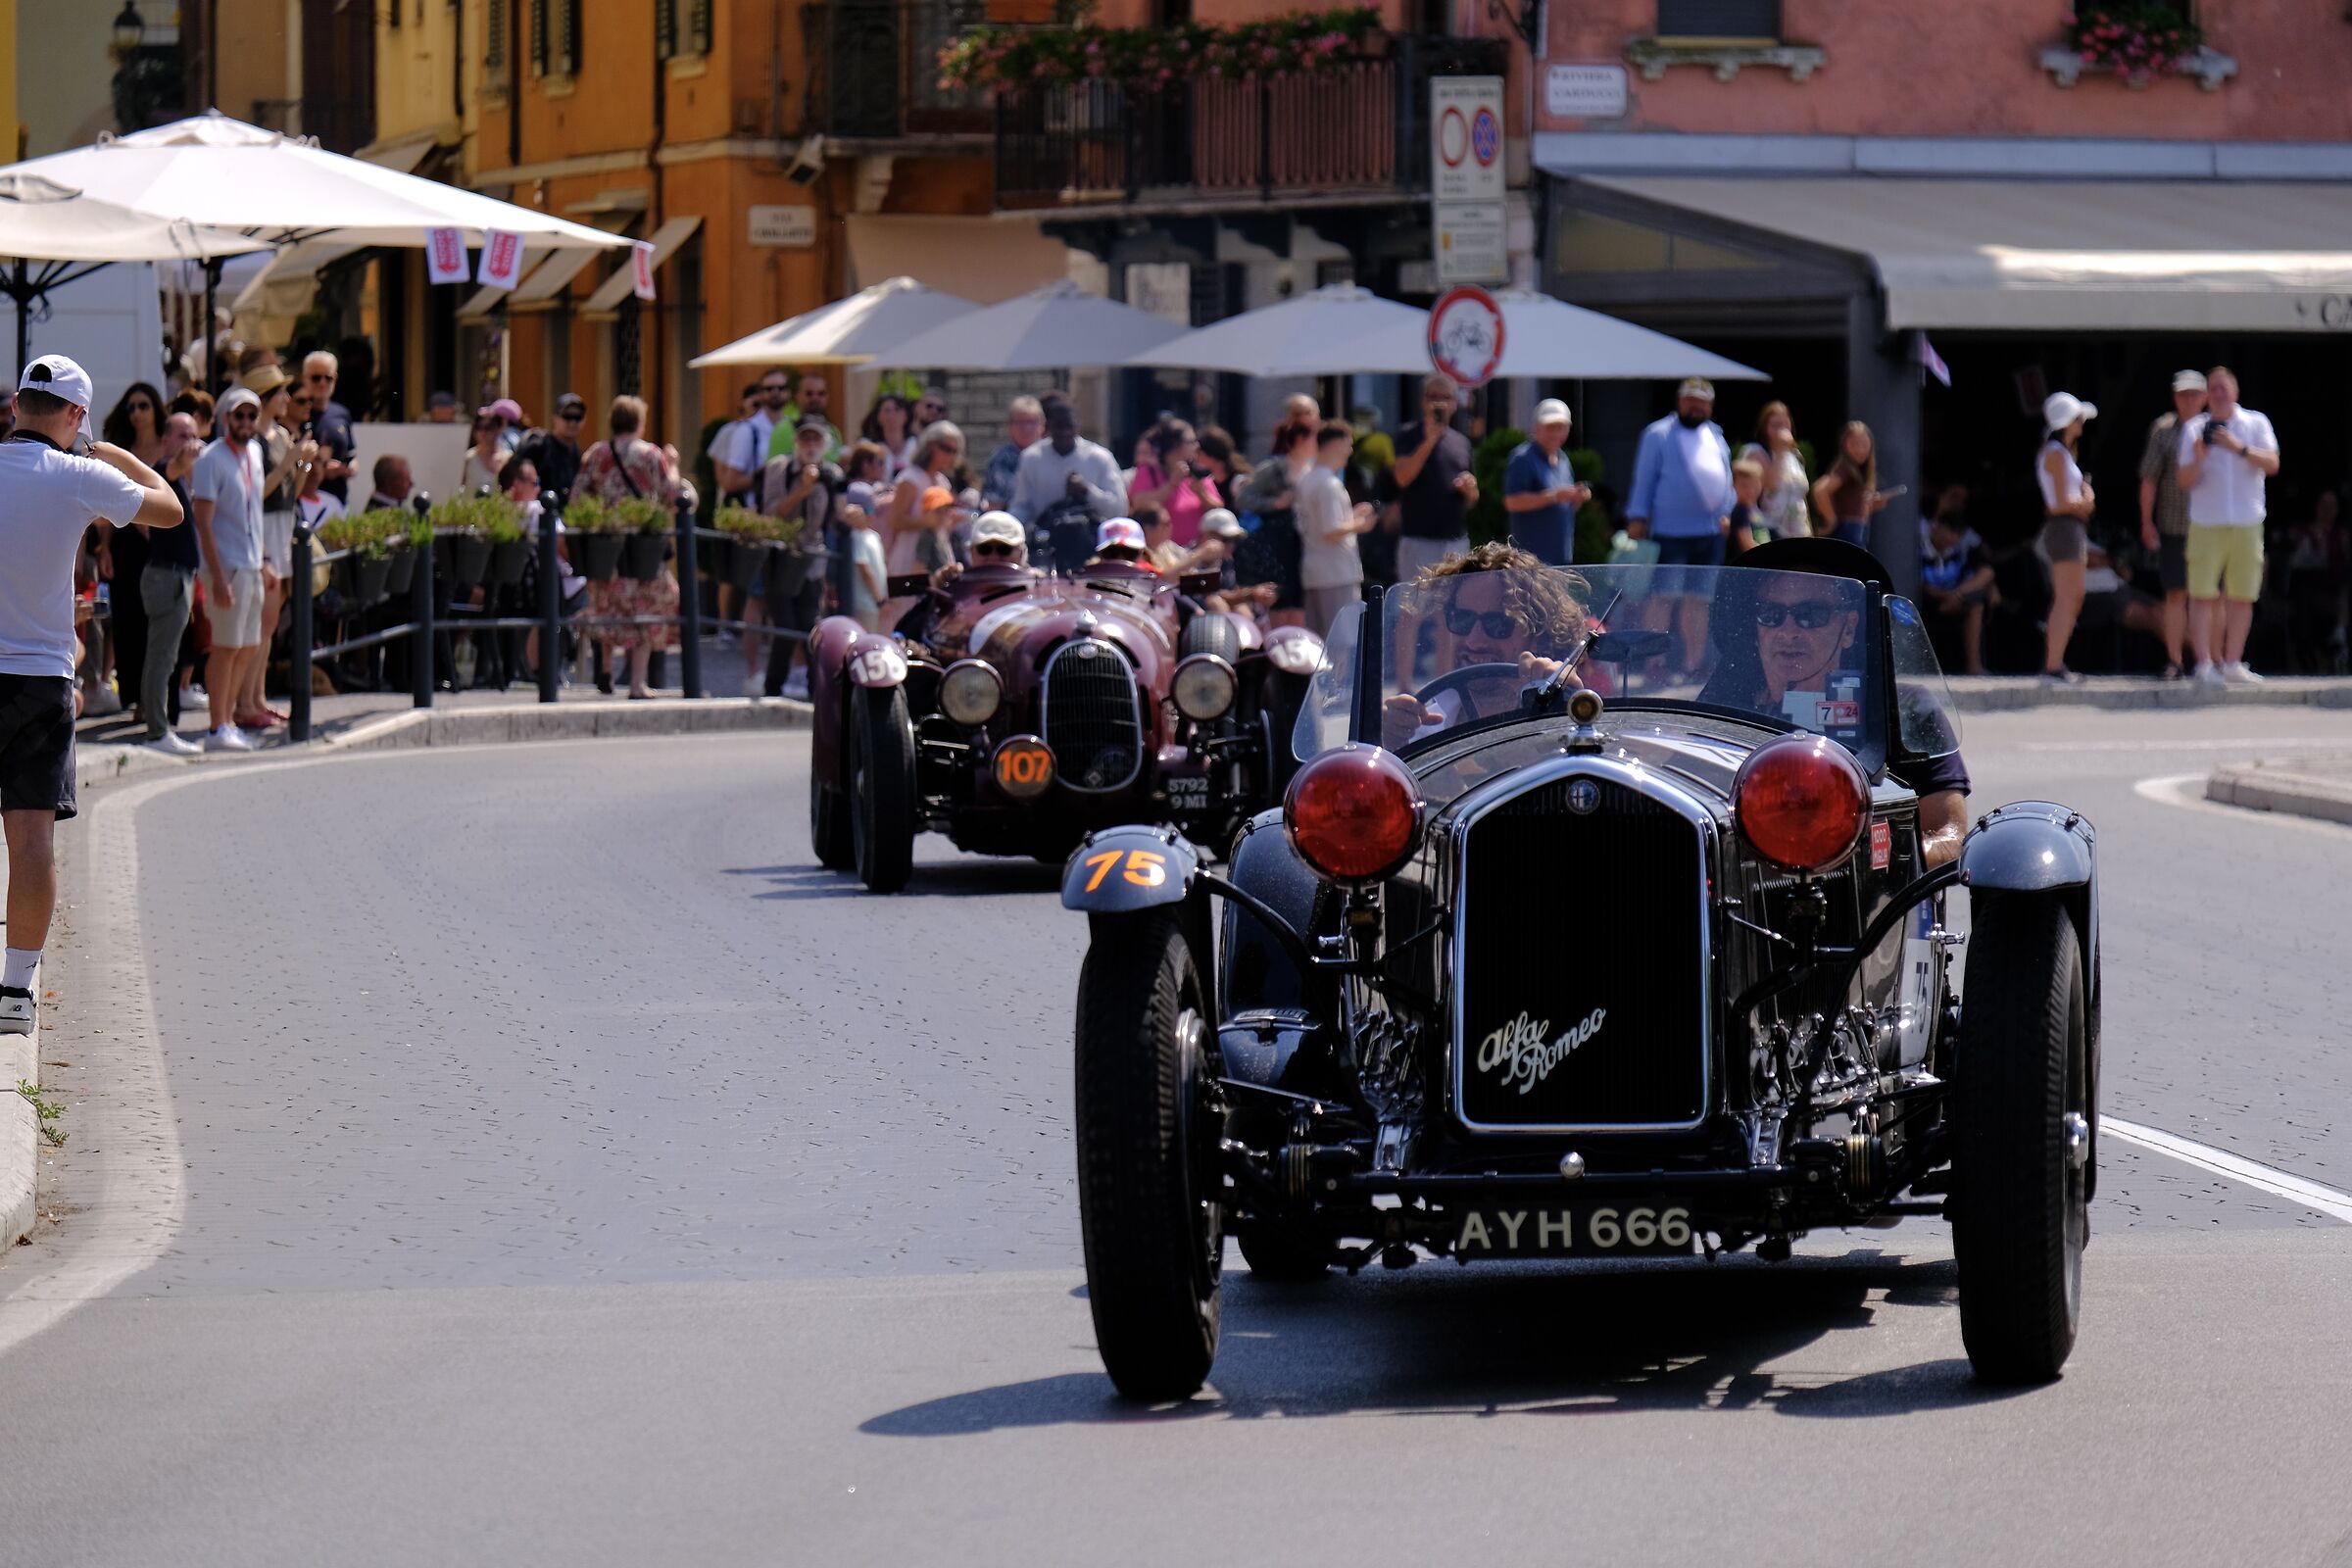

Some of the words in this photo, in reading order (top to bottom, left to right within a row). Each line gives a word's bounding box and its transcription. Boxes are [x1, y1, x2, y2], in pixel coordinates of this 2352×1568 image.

[1821, 707, 1832, 721] 7
[999, 749, 1052, 784] 107
[1168, 777, 1209, 792] 5792
[1085, 849, 1166, 893] 75
[1478, 1010, 1549, 1086] Alfa
[1514, 1007, 1607, 1096] Romeo
[1458, 1210, 1573, 1250] AYH
[1589, 1206, 1691, 1249] 666
